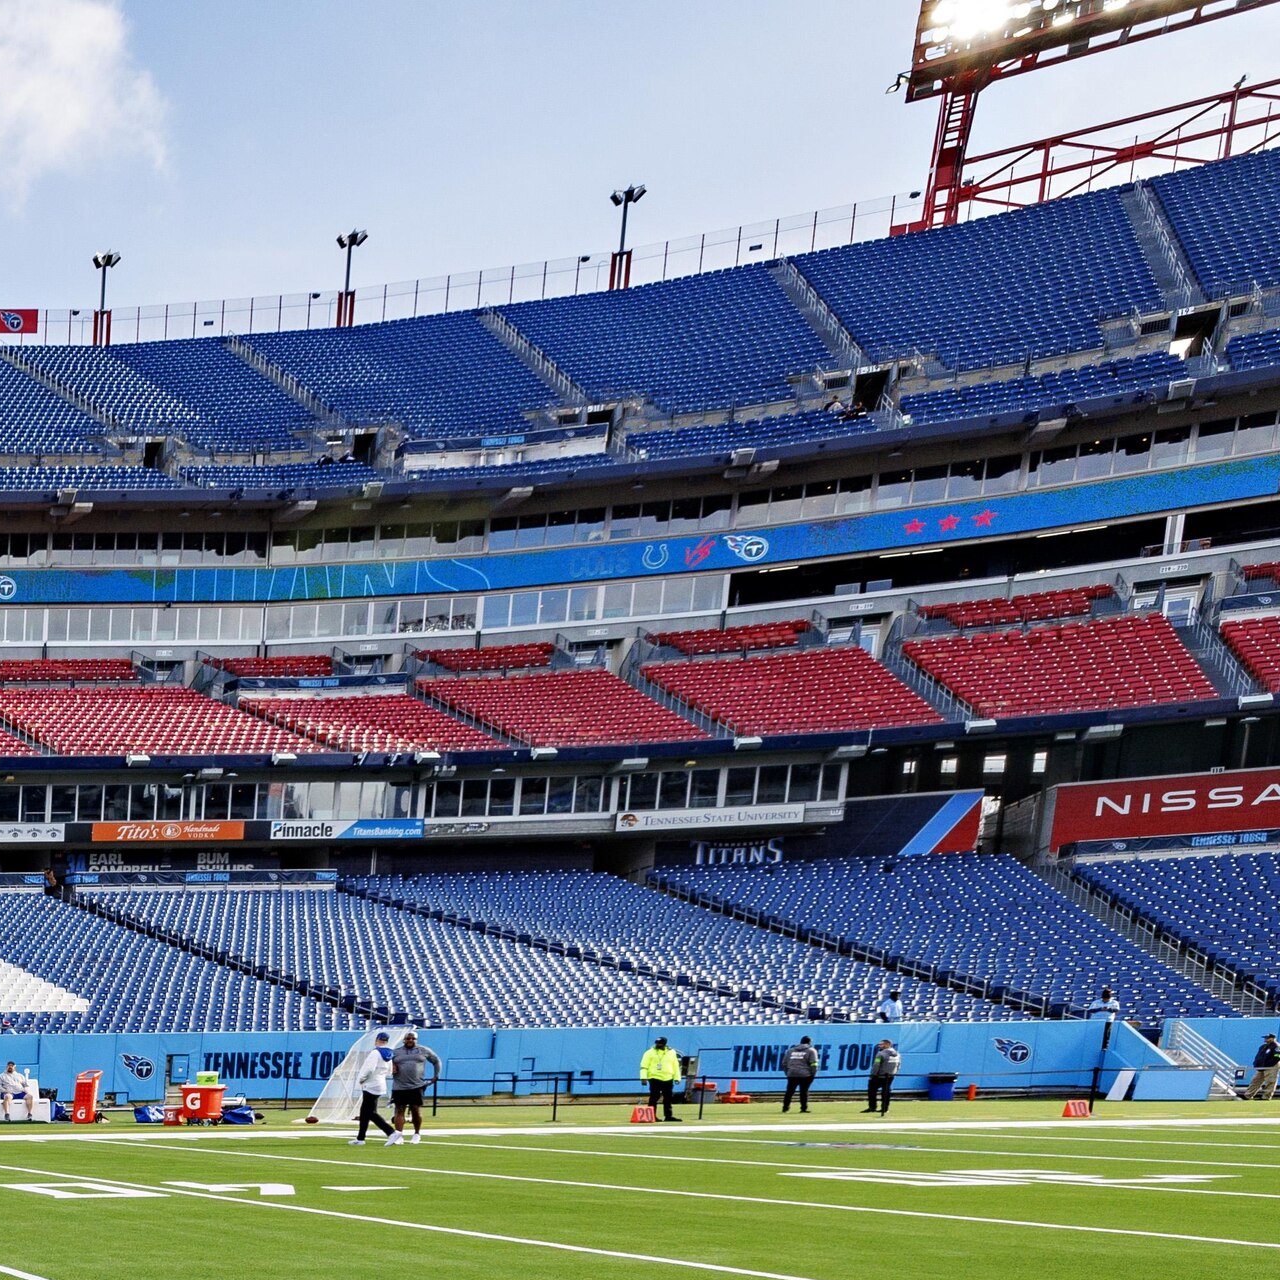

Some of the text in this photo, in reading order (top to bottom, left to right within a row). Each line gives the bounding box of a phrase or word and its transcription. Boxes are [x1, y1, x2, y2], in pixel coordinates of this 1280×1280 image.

[643, 809, 801, 827] TENNESSEE STATE UNIVERSITY
[273, 822, 333, 838] Pinnacle
[353, 827, 421, 838] TitansBanking.com
[197, 853, 229, 864] BUM
[690, 837, 784, 866] TITANS
[90, 854, 124, 865] EARL
[204, 1052, 302, 1079] TENNESSEE
[638, 1107, 653, 1122] 20
[1071, 1102, 1087, 1115] 10
